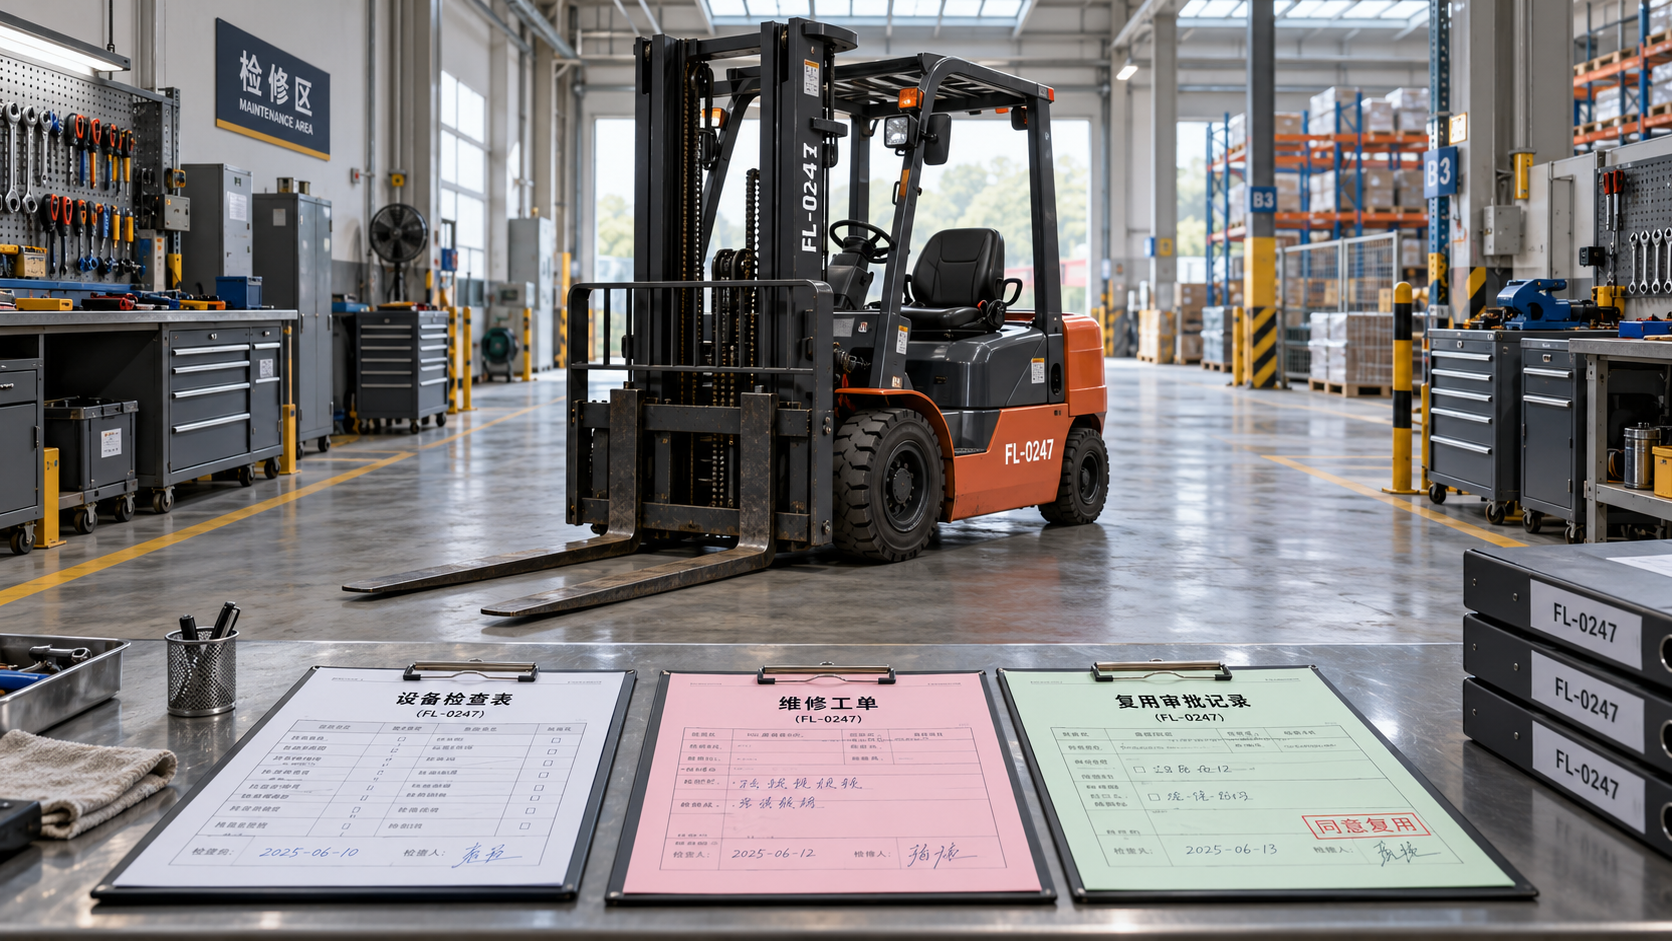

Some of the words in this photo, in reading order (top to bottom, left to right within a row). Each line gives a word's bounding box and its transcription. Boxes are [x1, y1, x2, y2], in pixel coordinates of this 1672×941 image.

[239, 49, 313, 117] 检修区
[239, 98, 295, 130] MAINTENANCE
[295, 119, 314, 136] AREA
[1427, 157, 1452, 188] B3
[1253, 192, 1274, 209] B3
[1005, 438, 1055, 466] FL-0247
[1553, 602, 1618, 644] FL-0247
[396, 691, 513, 707] 设备检查表
[778, 694, 879, 713] 维修工单
[1114, 692, 1252, 711] 复用审批记录
[1554, 676, 1619, 724] FL-0247
[415, 709, 486, 720] (FL-0247)
[794, 714, 863, 725] (FL-0247)
[1154, 713, 1226, 723] (FL-0247)
[1555, 748, 1620, 801] FL-0247
[1314, 816, 1418, 835] 同意复用
[258, 846, 360, 859] 2025-06-10
[731, 847, 817, 860] 2025-06-12
[1185, 843, 1279, 856] 2025-06-13
